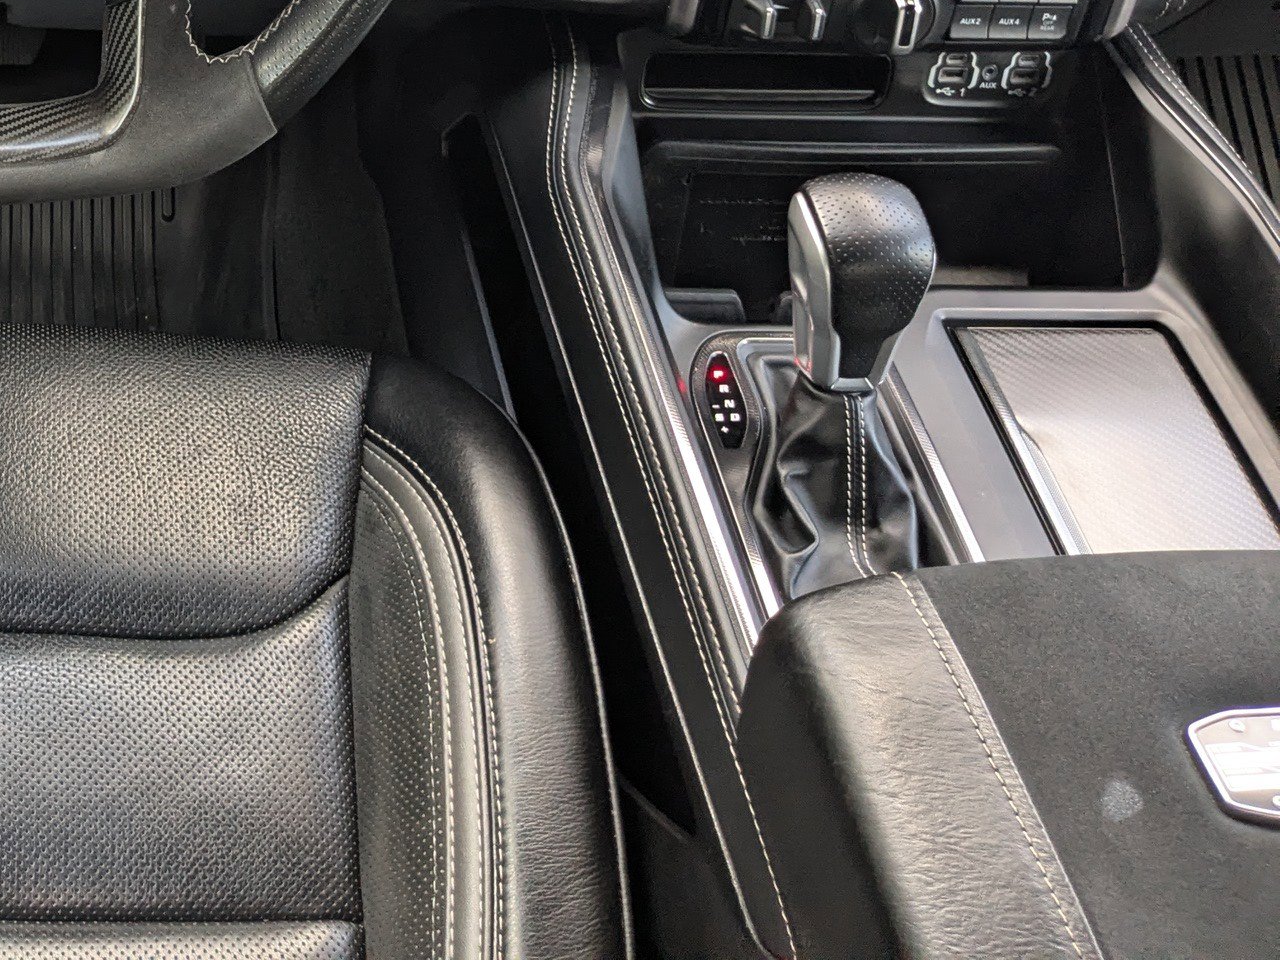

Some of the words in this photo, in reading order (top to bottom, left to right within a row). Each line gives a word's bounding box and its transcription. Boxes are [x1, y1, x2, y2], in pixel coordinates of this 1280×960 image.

[960, 88, 966, 96] 1
[713, 370, 723, 378] P
[724, 400, 735, 408] N
[730, 413, 740, 421] D
